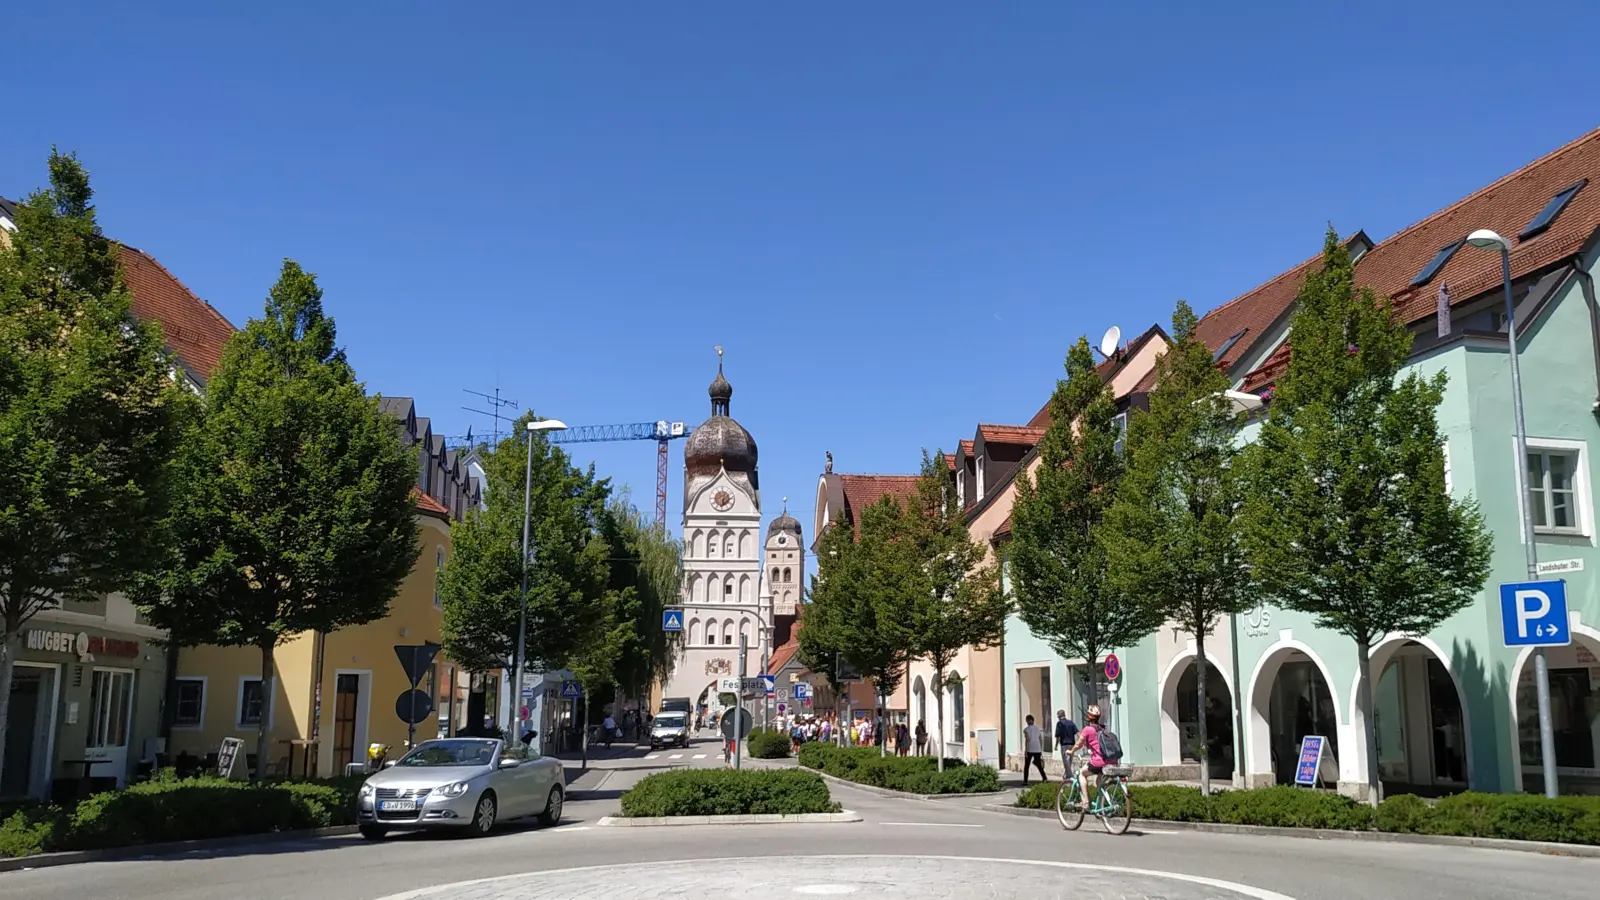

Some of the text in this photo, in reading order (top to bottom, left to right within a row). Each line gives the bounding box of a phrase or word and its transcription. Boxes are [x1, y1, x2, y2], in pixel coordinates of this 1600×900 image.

[1539, 560, 1580, 571] Landshuter Str.
[1514, 589, 1551, 638] P
[1536, 624, 1543, 637] 6
[27, 629, 75, 653] MUGBET
[722, 680, 764, 690] Fesplatz
[797, 685, 805, 698] P
